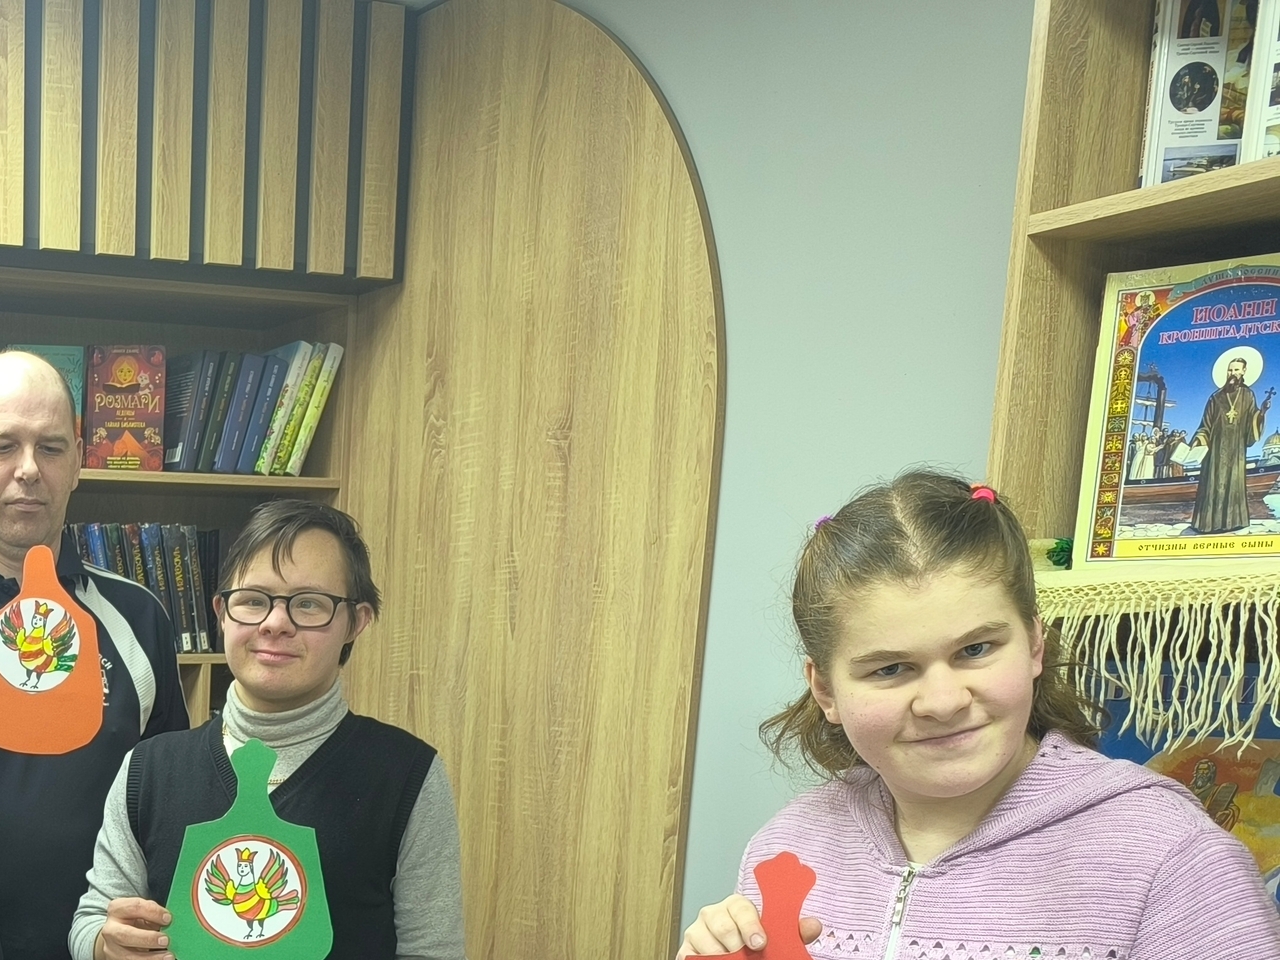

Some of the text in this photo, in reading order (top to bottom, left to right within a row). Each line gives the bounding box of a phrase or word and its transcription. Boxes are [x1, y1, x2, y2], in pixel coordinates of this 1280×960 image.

[1191, 298, 1277, 325] ИОАНН
[94, 393, 160, 413] РОЗМАРИ
[1138, 540, 1274, 551] ОТЧИЗНЫ ВЕРНЫЕ СЫНЫ
